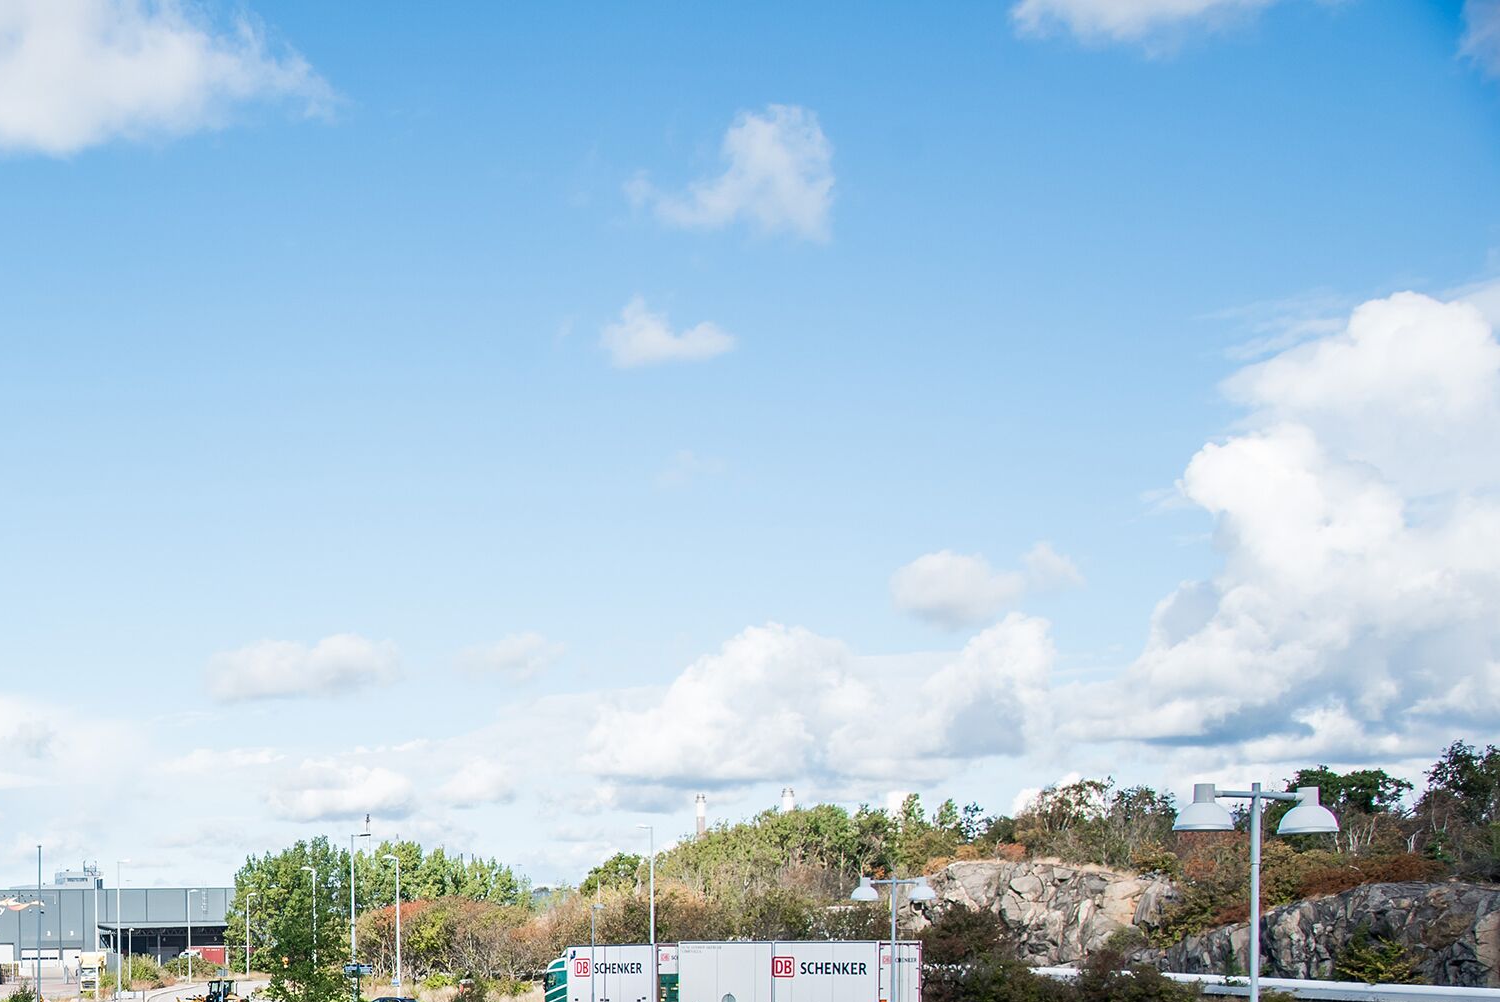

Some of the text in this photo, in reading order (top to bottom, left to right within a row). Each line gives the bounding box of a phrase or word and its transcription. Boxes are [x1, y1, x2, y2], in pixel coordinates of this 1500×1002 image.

[576, 962, 642, 974] DB SCHENKER
[775, 960, 867, 975] DB SCHENKER
